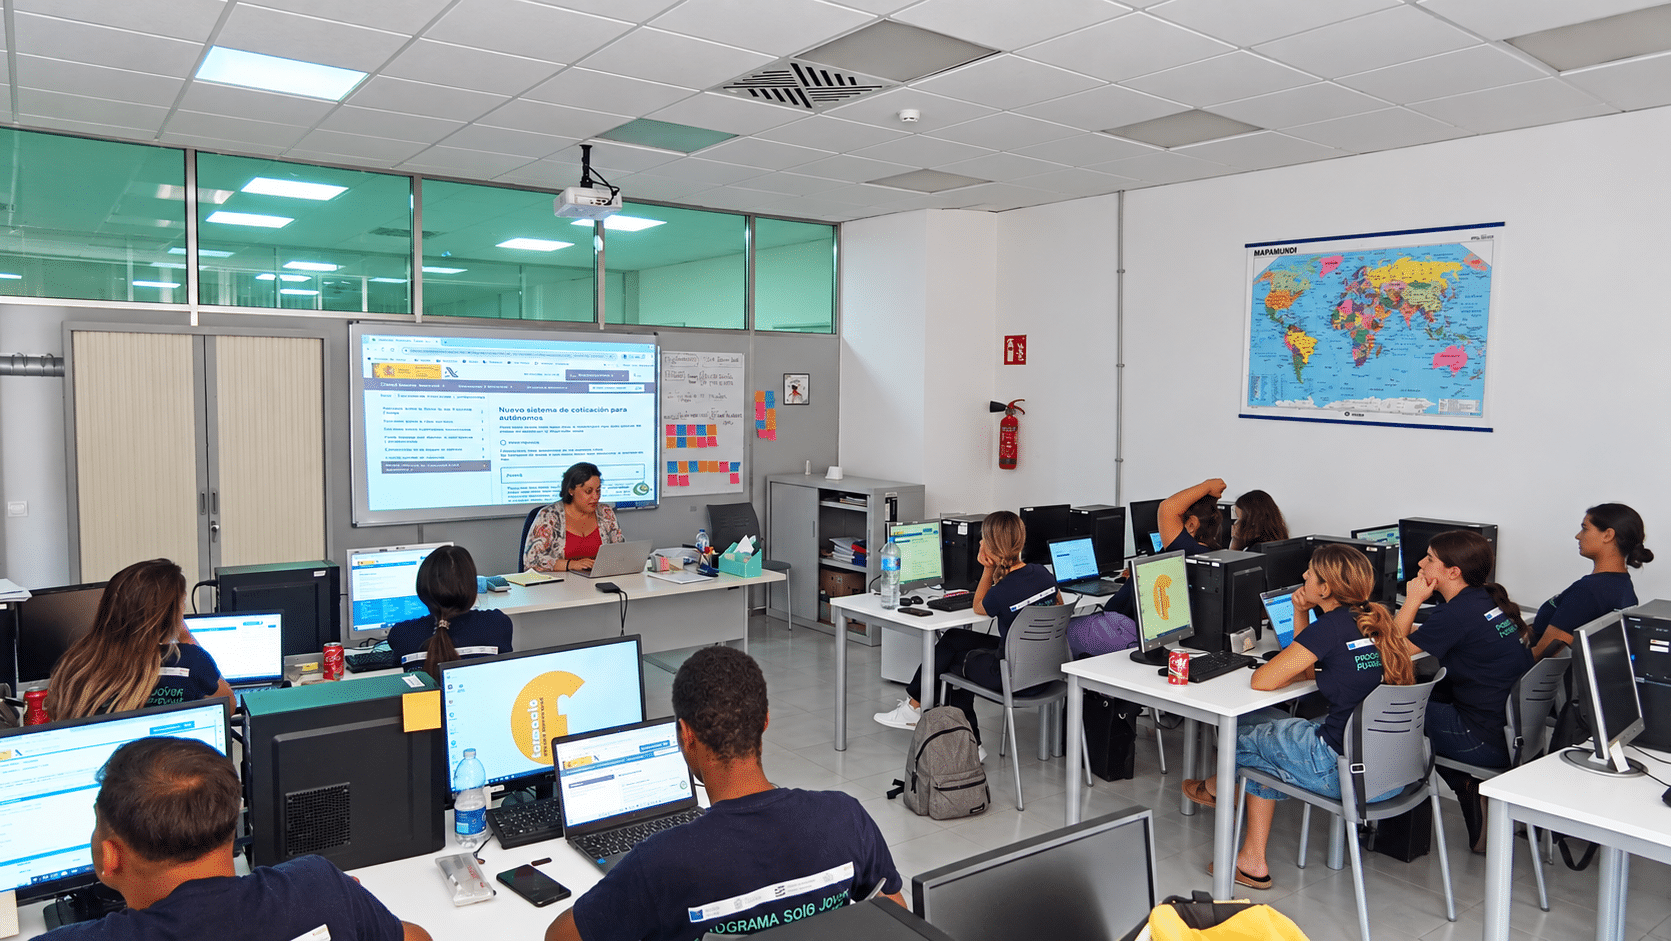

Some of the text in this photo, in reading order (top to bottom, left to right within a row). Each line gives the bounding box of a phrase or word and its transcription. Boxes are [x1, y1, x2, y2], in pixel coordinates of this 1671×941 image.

[1254, 247, 1297, 256] MAPAMUNDI
[610, 407, 628, 415] para
[710, 913, 779, 934] OGRAMA
